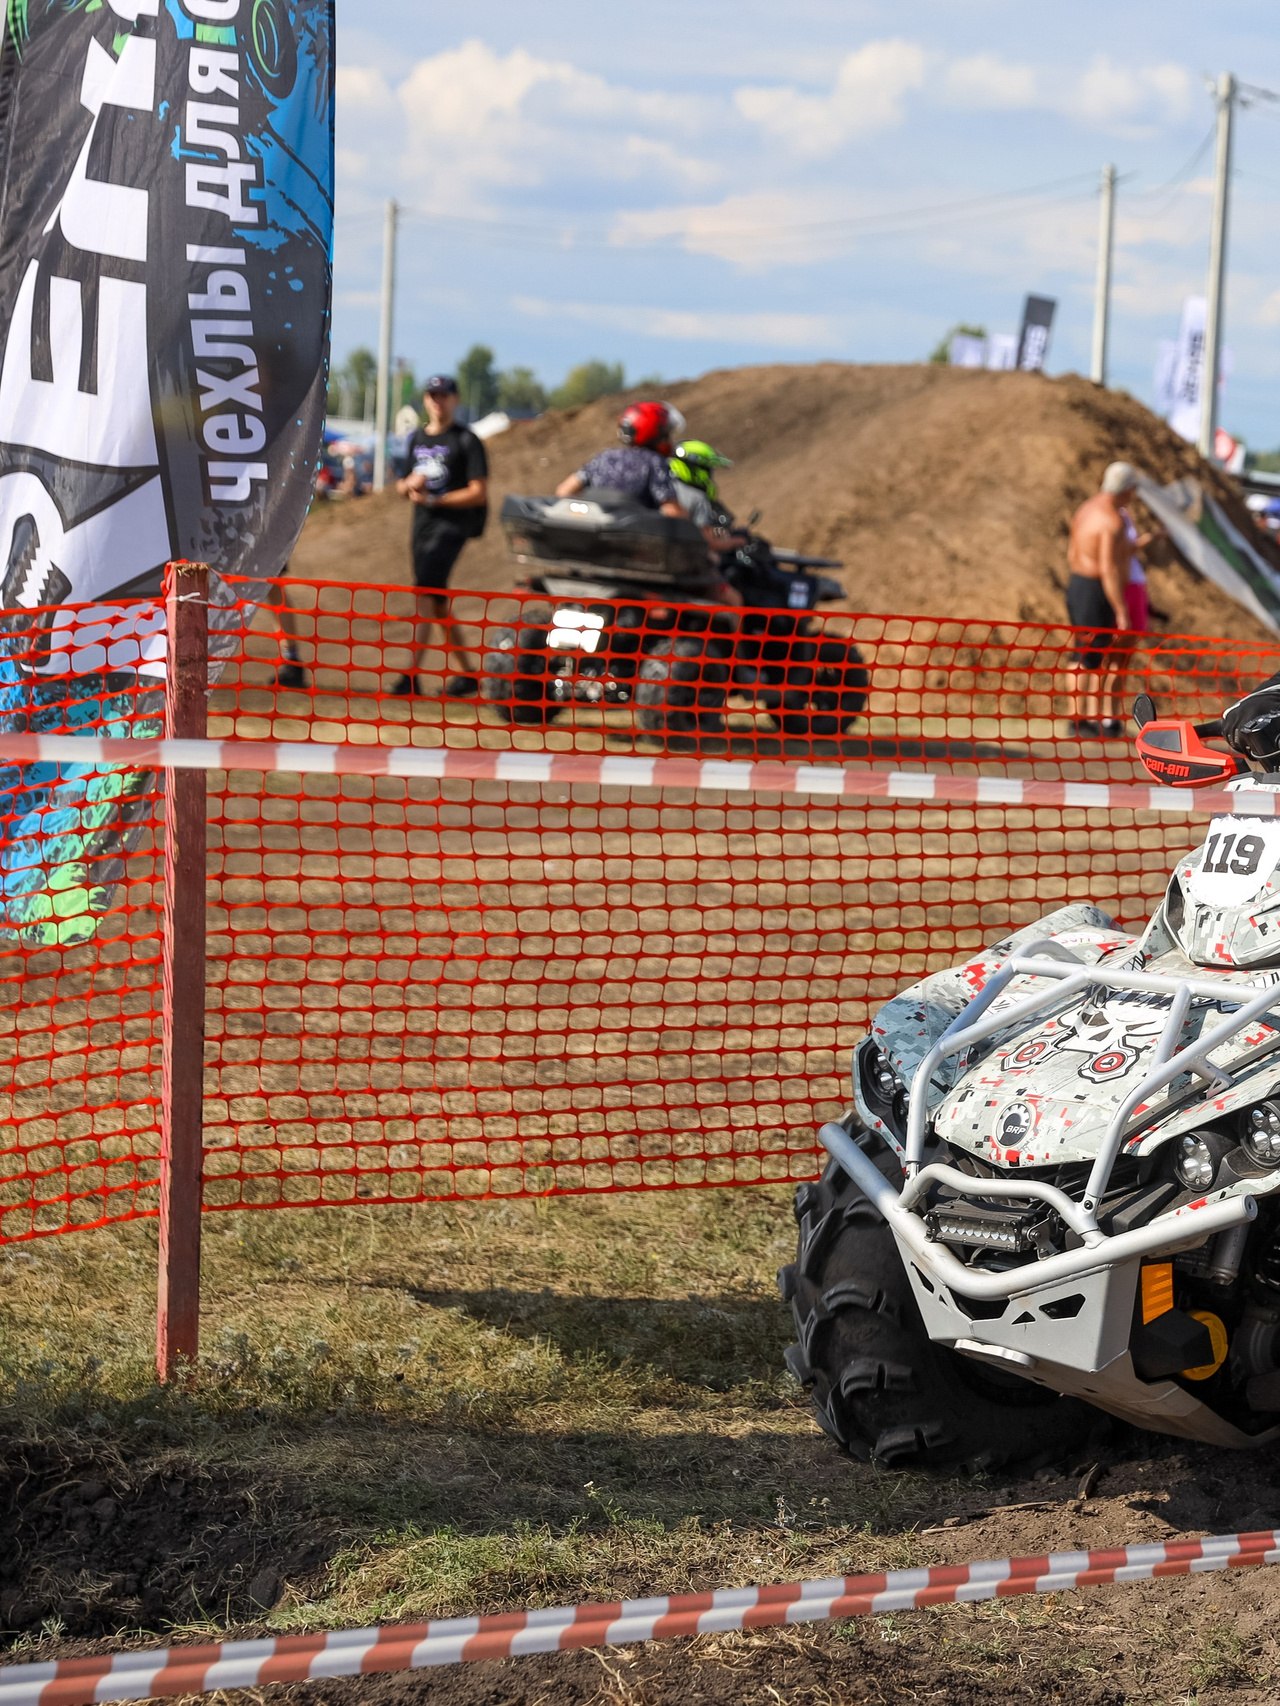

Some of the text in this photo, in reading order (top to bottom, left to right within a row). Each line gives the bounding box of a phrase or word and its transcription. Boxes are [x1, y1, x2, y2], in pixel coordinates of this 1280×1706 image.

[185, 46, 260, 224] для
[187, 244, 269, 503] чехлы
[1146, 757, 1190, 777] can-am
[1202, 833, 1266, 876] 119
[1005, 1125, 1027, 1135] BRP
